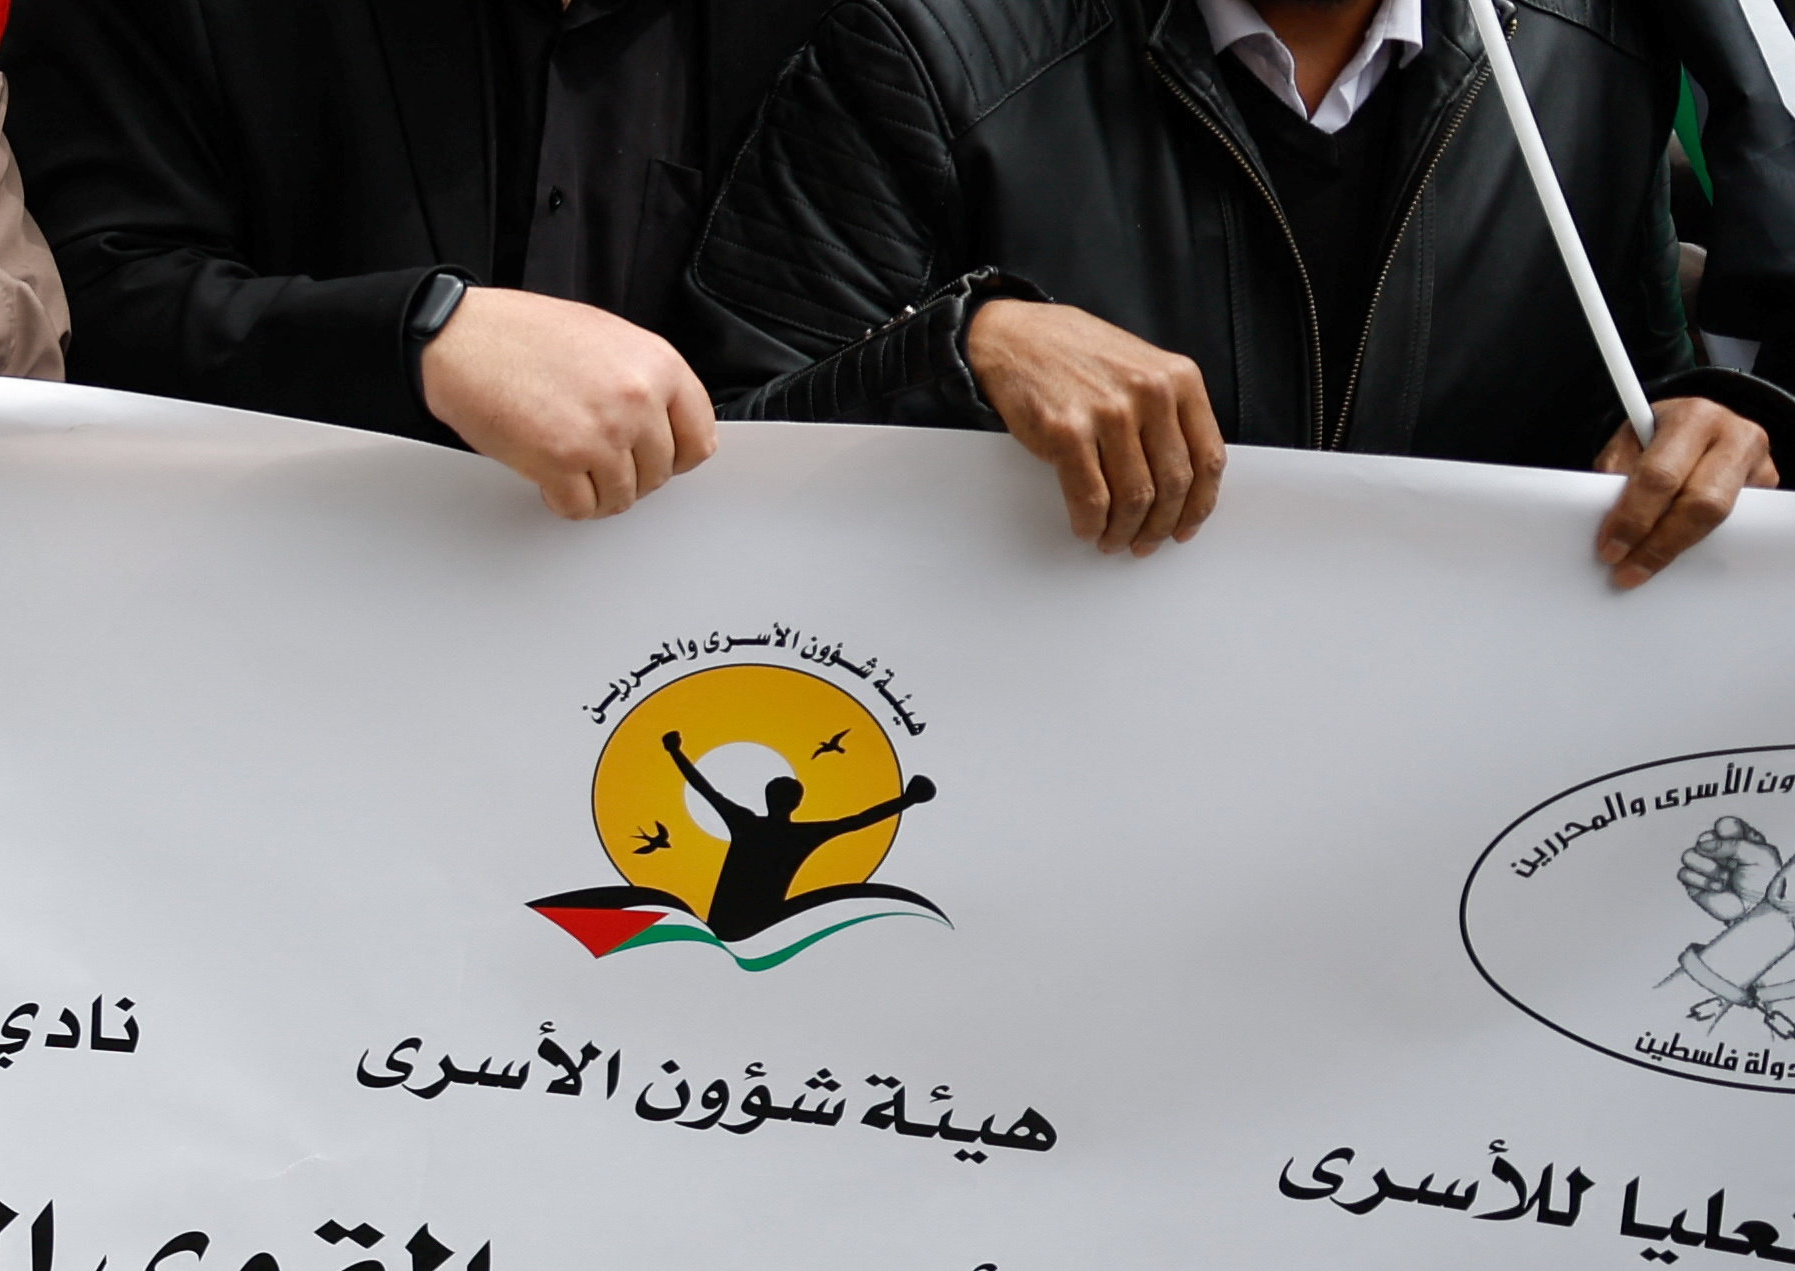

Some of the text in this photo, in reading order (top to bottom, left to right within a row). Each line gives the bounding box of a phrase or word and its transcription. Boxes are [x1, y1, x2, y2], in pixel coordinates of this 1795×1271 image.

[583, 622, 926, 737] هيئة شؤون الأسرى والمحررين
[1511, 792, 1646, 877] والمحررين
[1655, 763, 1753, 810] الأسرى
[357, 1022, 1057, 1164] هيئة شؤون الأسرى
[1636, 1032, 1738, 1071] فلسطين
[1279, 1140, 1795, 1264] عليا للأسرى
